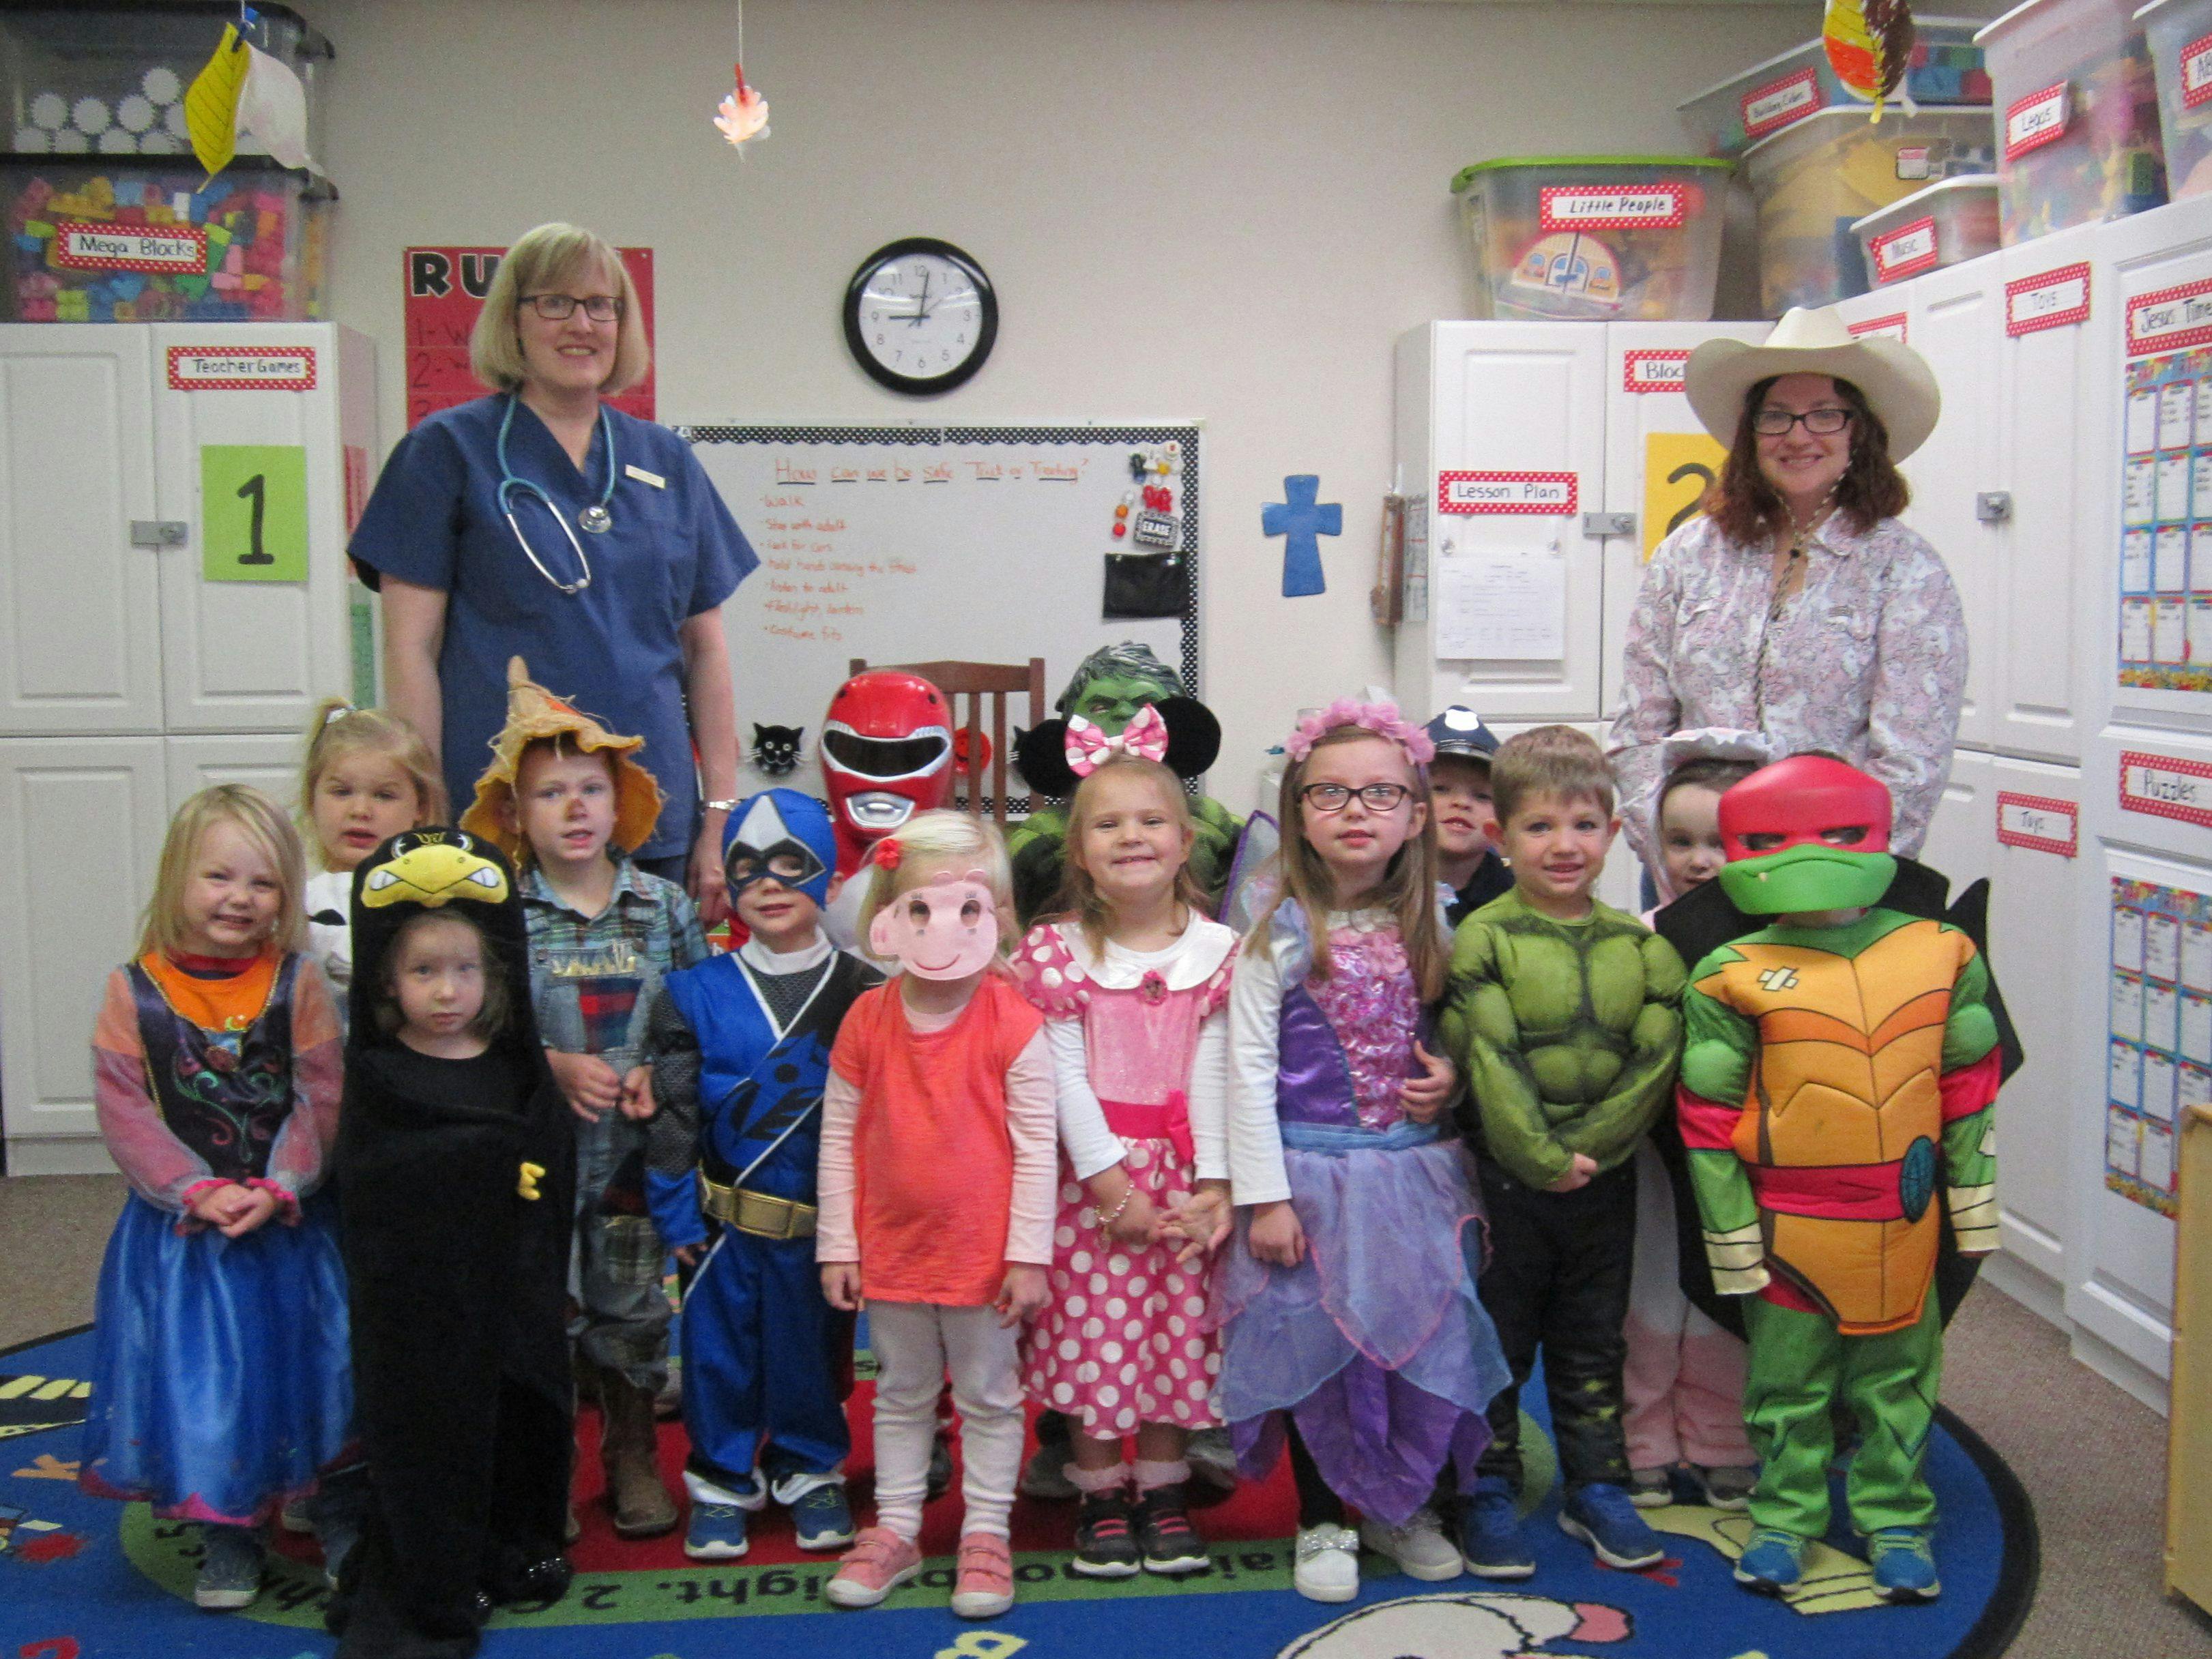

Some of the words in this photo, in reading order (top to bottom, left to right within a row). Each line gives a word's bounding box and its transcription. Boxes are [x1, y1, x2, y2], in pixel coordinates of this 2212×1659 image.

[1569, 199, 1614, 214] Little
[1618, 196, 1665, 214] People
[79, 235, 128, 258] Mega
[139, 238, 194, 257] Blocks
[411, 252, 501, 298] RU
[2141, 307, 2174, 333] Jesus
[192, 357, 256, 373] Teacher
[257, 359, 301, 373] Games
[1646, 361, 1688, 379] Bloc
[776, 458, 817, 481] How
[1457, 482, 1511, 499] Lesson
[1524, 483, 1560, 499] Plan
[1666, 463, 1716, 538] 2
[237, 473, 275, 565] 1
[2144, 769, 2196, 803] Puzzles
[656, 1569, 836, 1606] ight.
